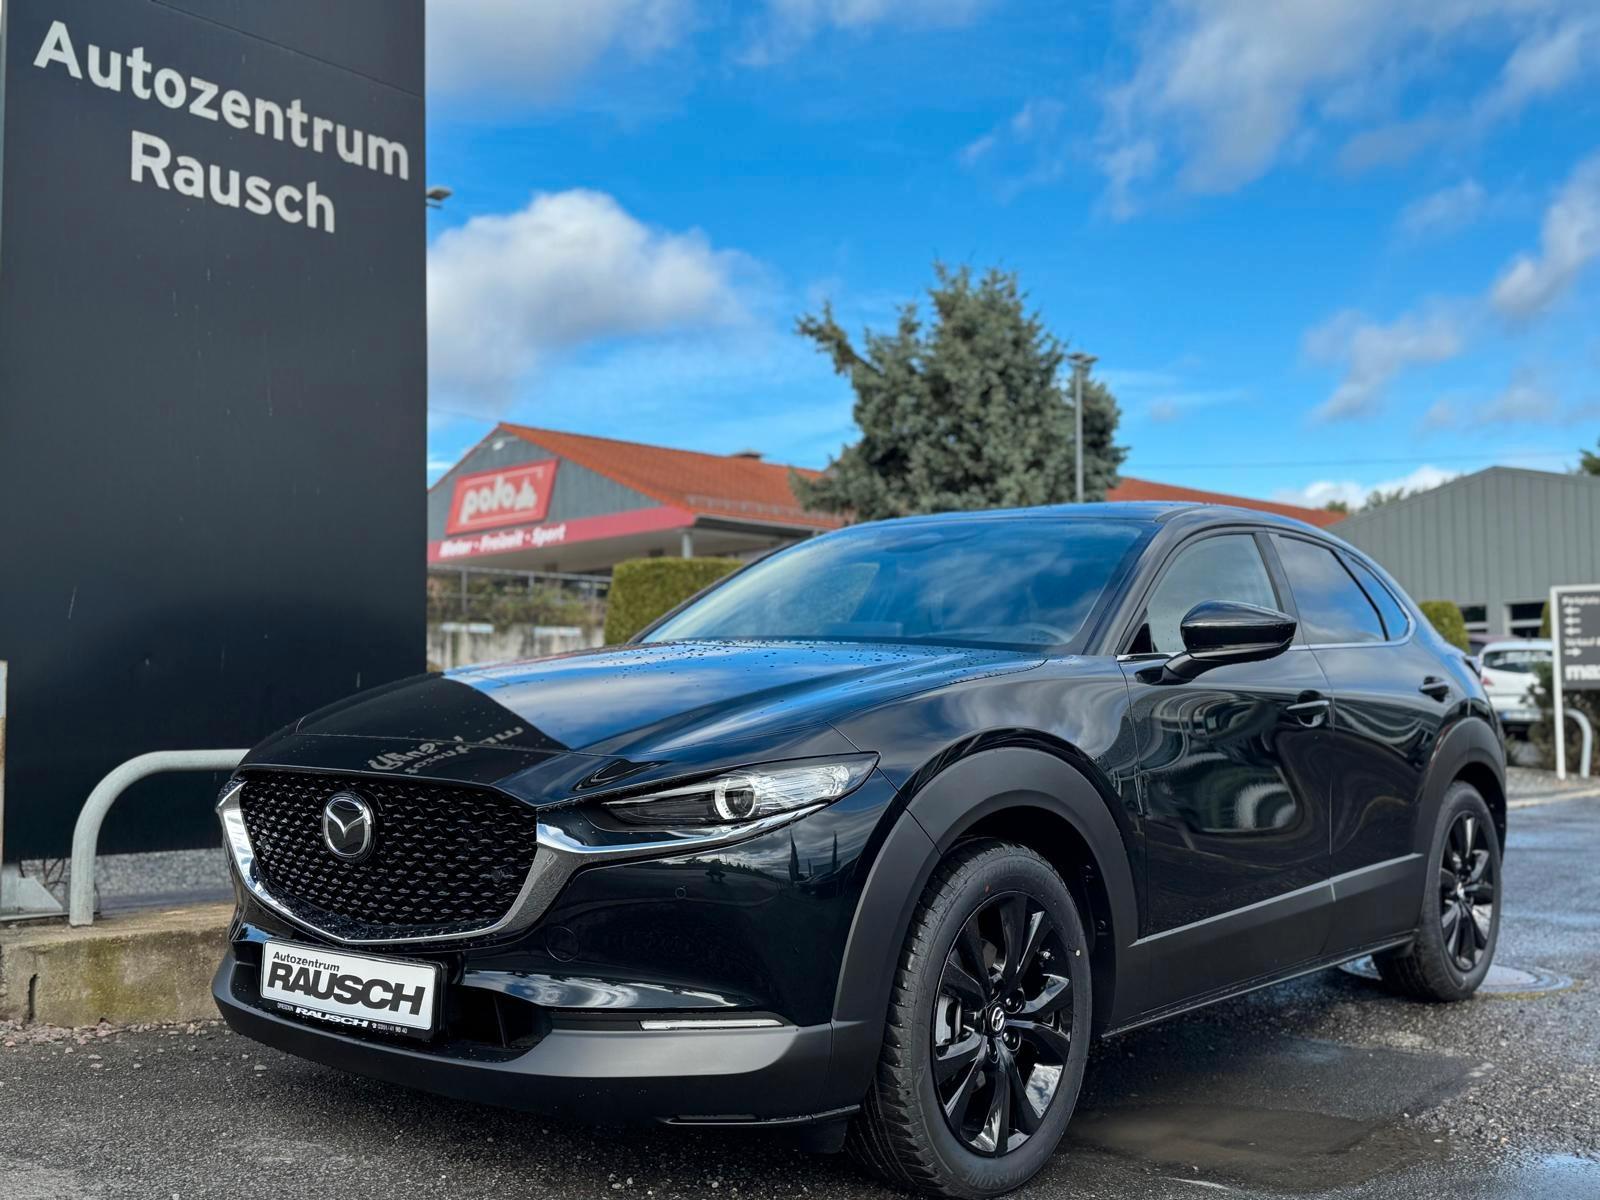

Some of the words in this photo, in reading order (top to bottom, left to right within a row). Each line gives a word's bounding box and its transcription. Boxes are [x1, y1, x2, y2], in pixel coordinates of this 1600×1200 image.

[33, 20, 409, 180] Autozentrum
[130, 130, 335, 233] Rausch
[459, 475, 516, 525] polo
[531, 523, 566, 547] Sport
[273, 951, 340, 972] Autozentrum
[267, 961, 426, 1016] RAUSCH
[295, 1007, 369, 1028] RAUSCH
